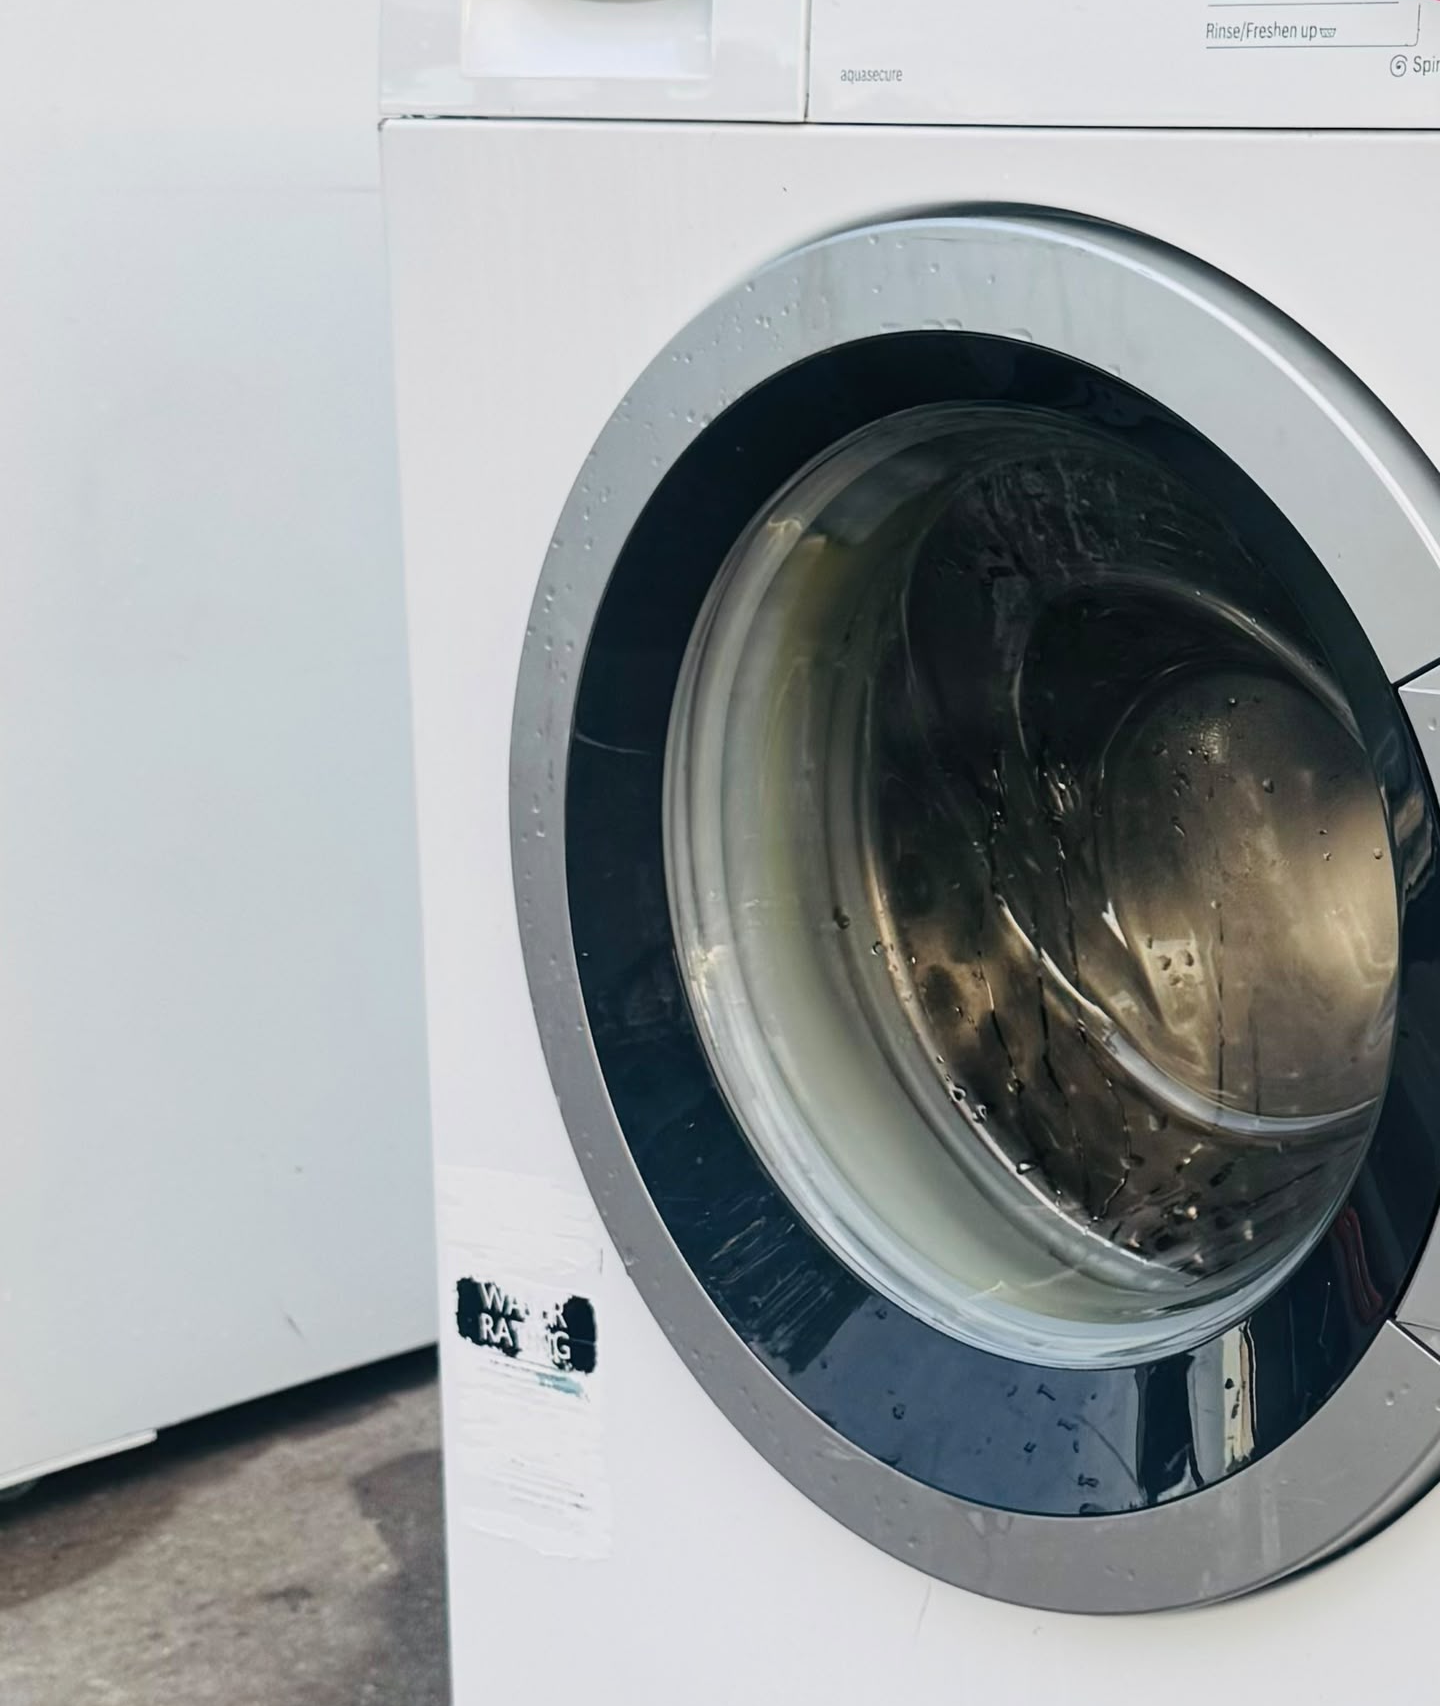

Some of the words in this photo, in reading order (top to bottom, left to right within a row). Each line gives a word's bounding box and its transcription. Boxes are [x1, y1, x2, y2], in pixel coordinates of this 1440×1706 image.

[1205, 22, 1298, 41] Rinse/Freshen
[1300, 26, 1318, 42] up
[840, 67, 903, 85] aquasecure
[480, 1281, 568, 1329] WAR
